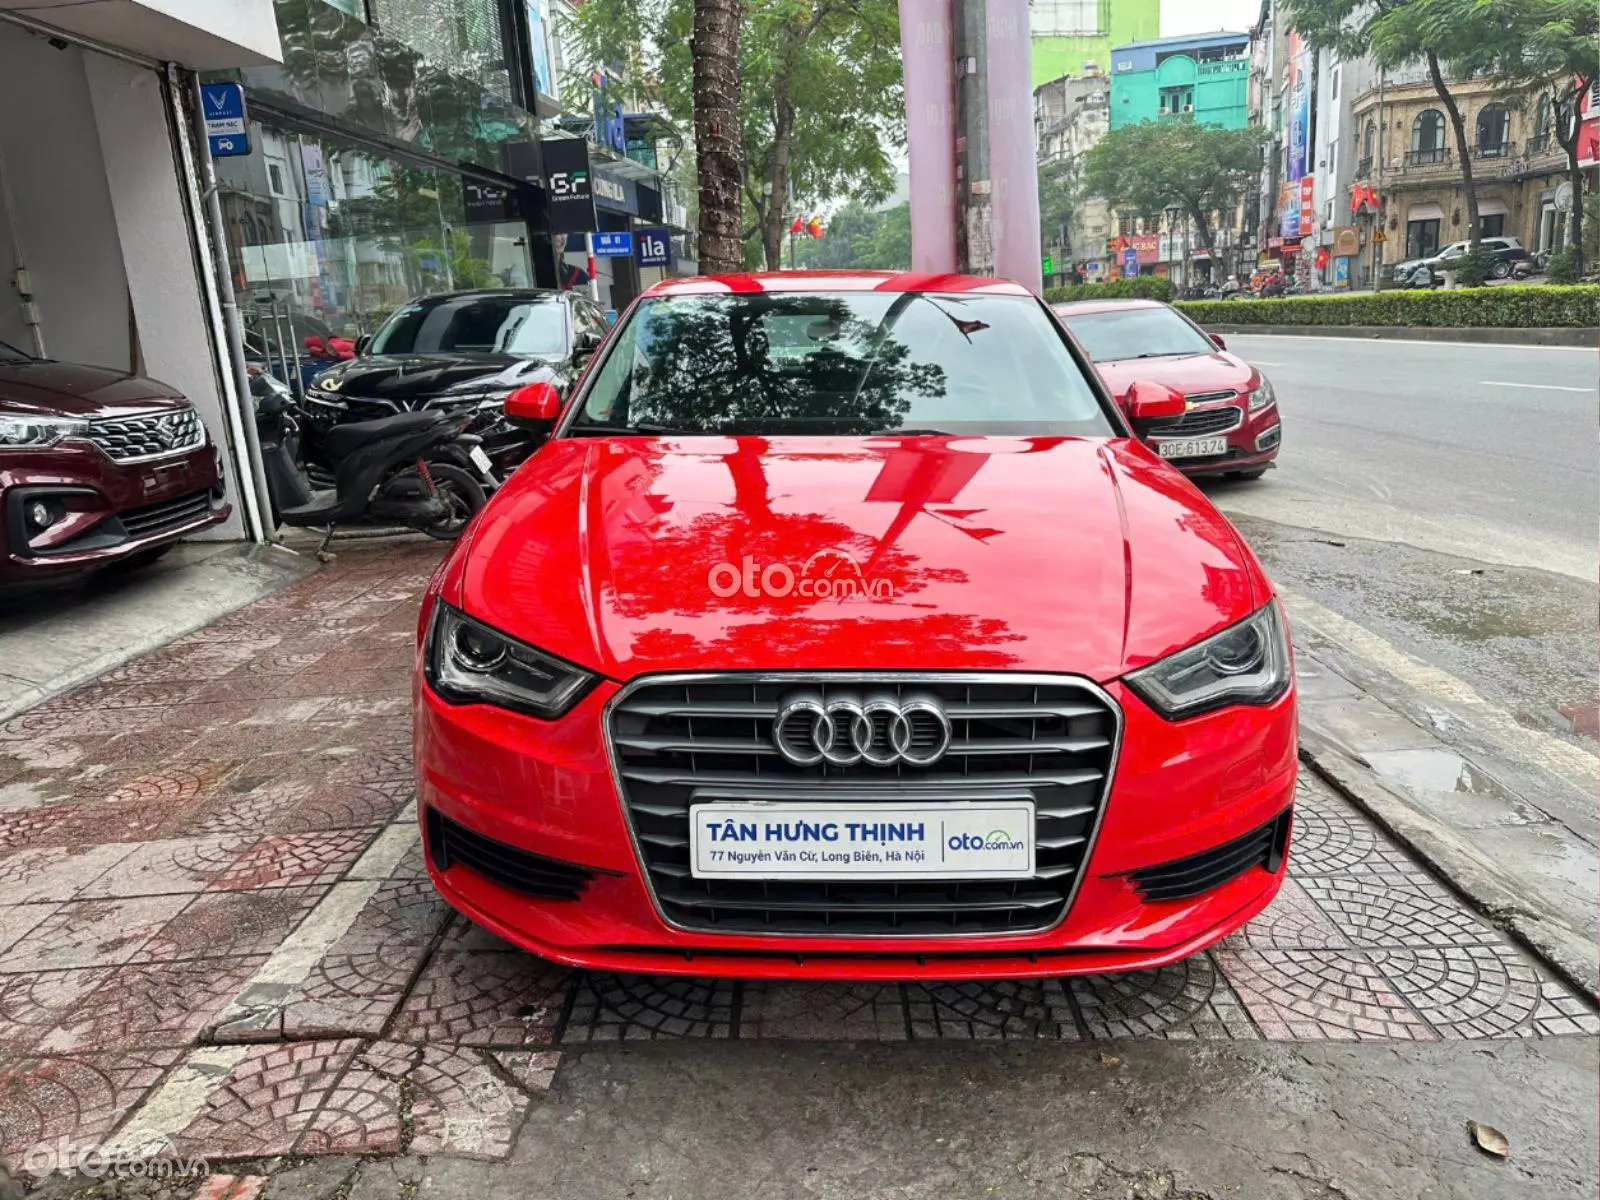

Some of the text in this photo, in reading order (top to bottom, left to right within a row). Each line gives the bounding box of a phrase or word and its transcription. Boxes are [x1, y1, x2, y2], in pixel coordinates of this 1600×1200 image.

[640, 236, 666, 256] ila
[706, 818, 925, 847] TÂN HƯNG THỊNH
[948, 833, 1024, 851] oto.com.vn
[710, 850, 925, 864] 77 Nguyễn Văn Cừ, Long Biên, Hà Nội
